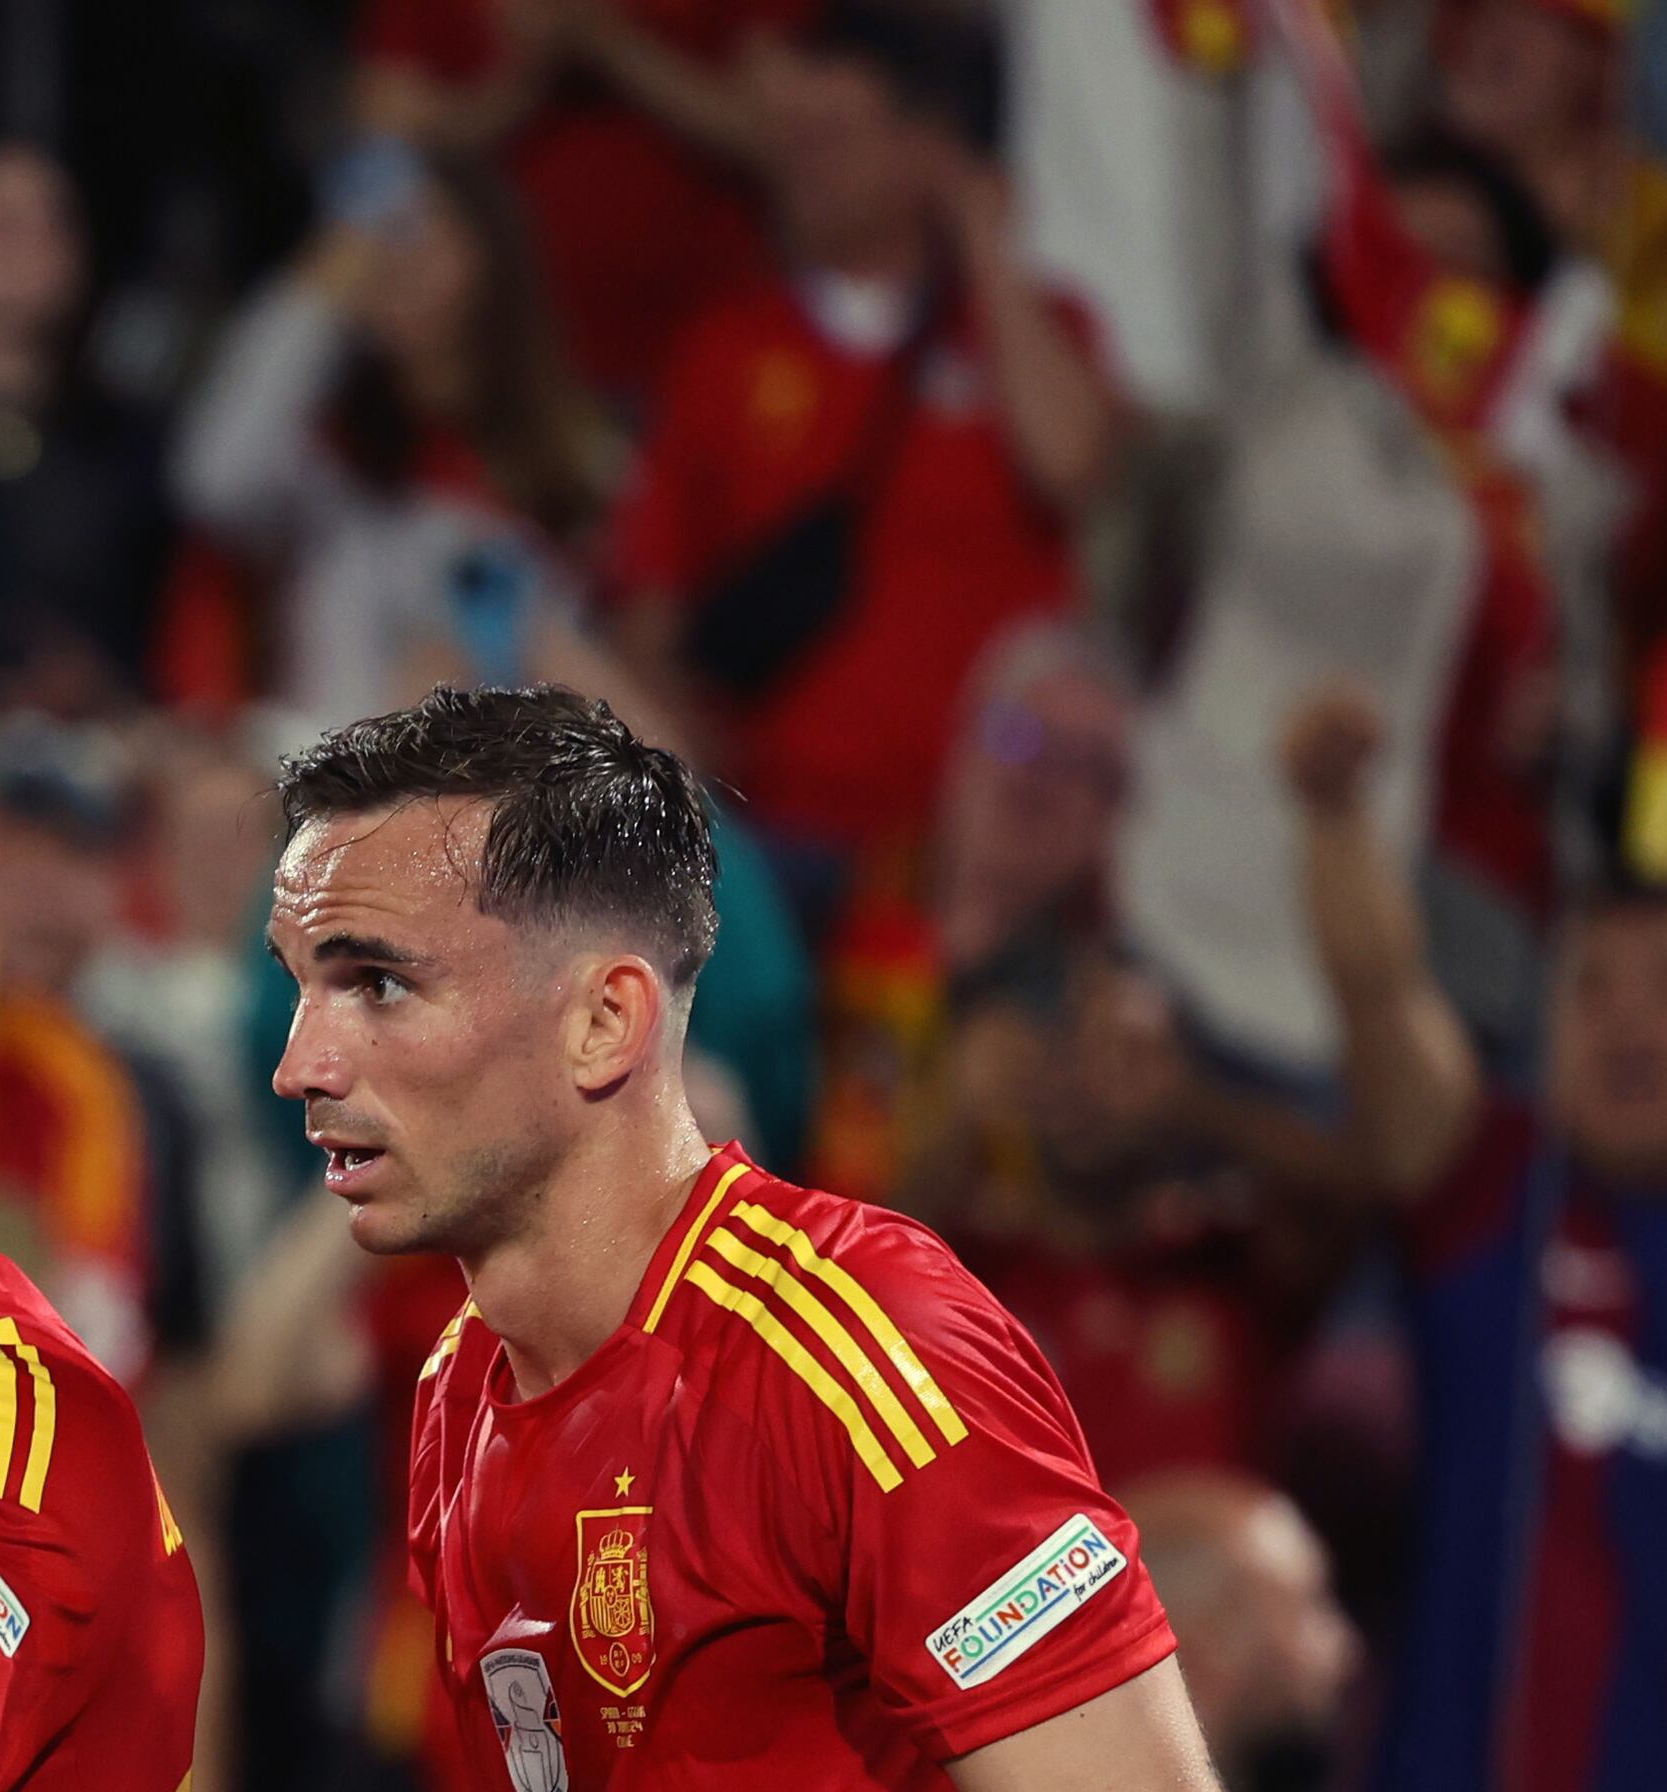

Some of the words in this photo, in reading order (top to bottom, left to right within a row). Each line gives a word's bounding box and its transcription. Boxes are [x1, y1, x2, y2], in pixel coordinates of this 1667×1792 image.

[1073, 1583, 1086, 1602] for
[1089, 1557, 1118, 1587] children
[933, 1617, 973, 1652] UEFA
